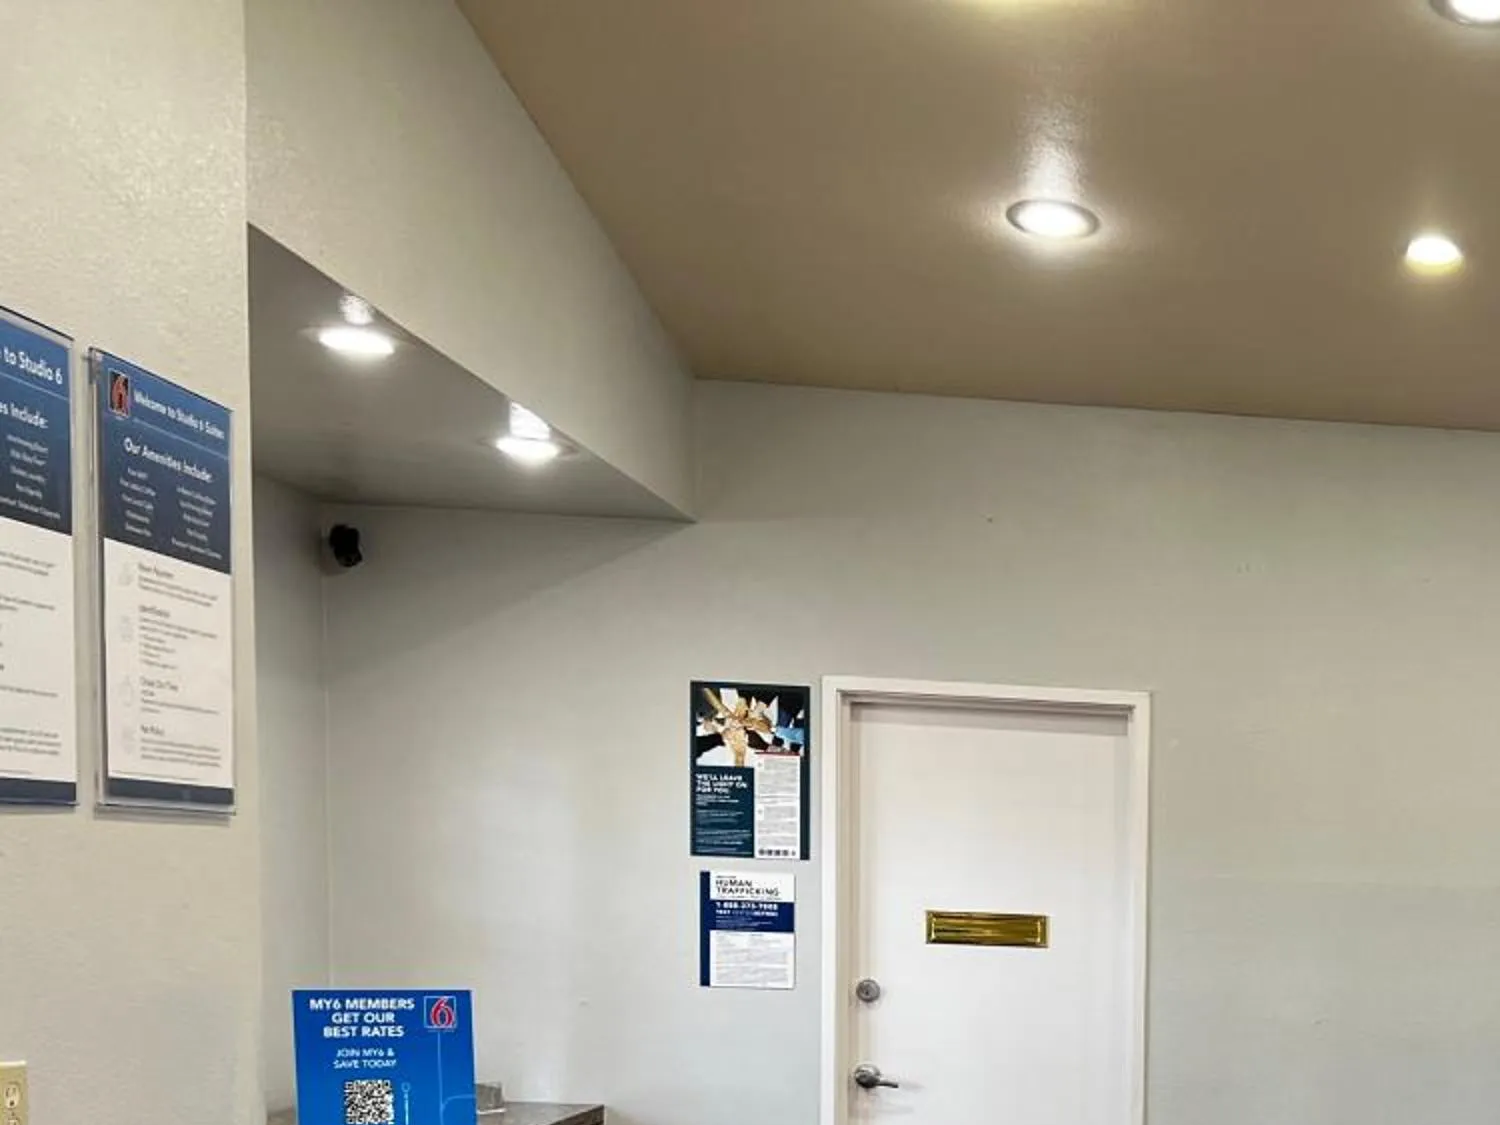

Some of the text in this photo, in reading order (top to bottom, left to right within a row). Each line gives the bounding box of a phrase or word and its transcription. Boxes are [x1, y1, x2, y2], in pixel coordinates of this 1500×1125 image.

[18, 351, 53, 381] Studio
[55, 367, 62, 385] 6
[123, 437, 141, 456] Our
[715, 879, 753, 888] HUMAN
[715, 887, 779, 898] TRAFFICKING
[309, 998, 416, 1011] MY6 MEMBERS
[331, 1012, 396, 1024] GET OUR
[323, 1026, 405, 1039] BEST RATES
[335, 1048, 361, 1058] JOIN
[362, 1048, 385, 1058] MY6
[333, 1059, 397, 1070] SAVE TODAY
